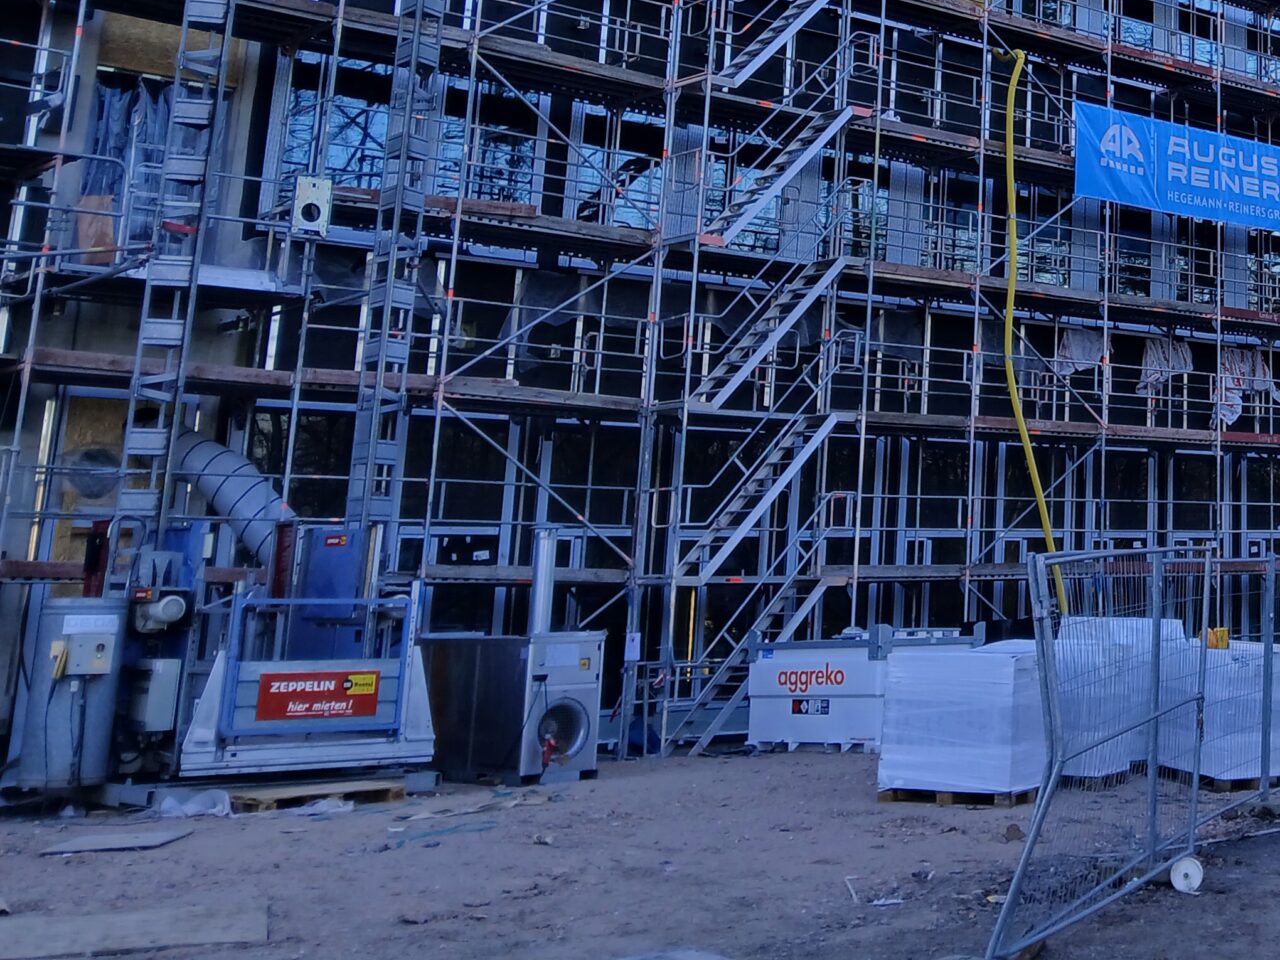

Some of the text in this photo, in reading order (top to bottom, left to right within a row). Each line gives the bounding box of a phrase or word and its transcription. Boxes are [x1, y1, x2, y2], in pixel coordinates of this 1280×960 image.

[1167, 190, 1222, 208] HEGEMANN
[778, 662, 845, 693] aggreko
[269, 681, 336, 693] ZEPPELIN
[287, 700, 309, 712] hier
